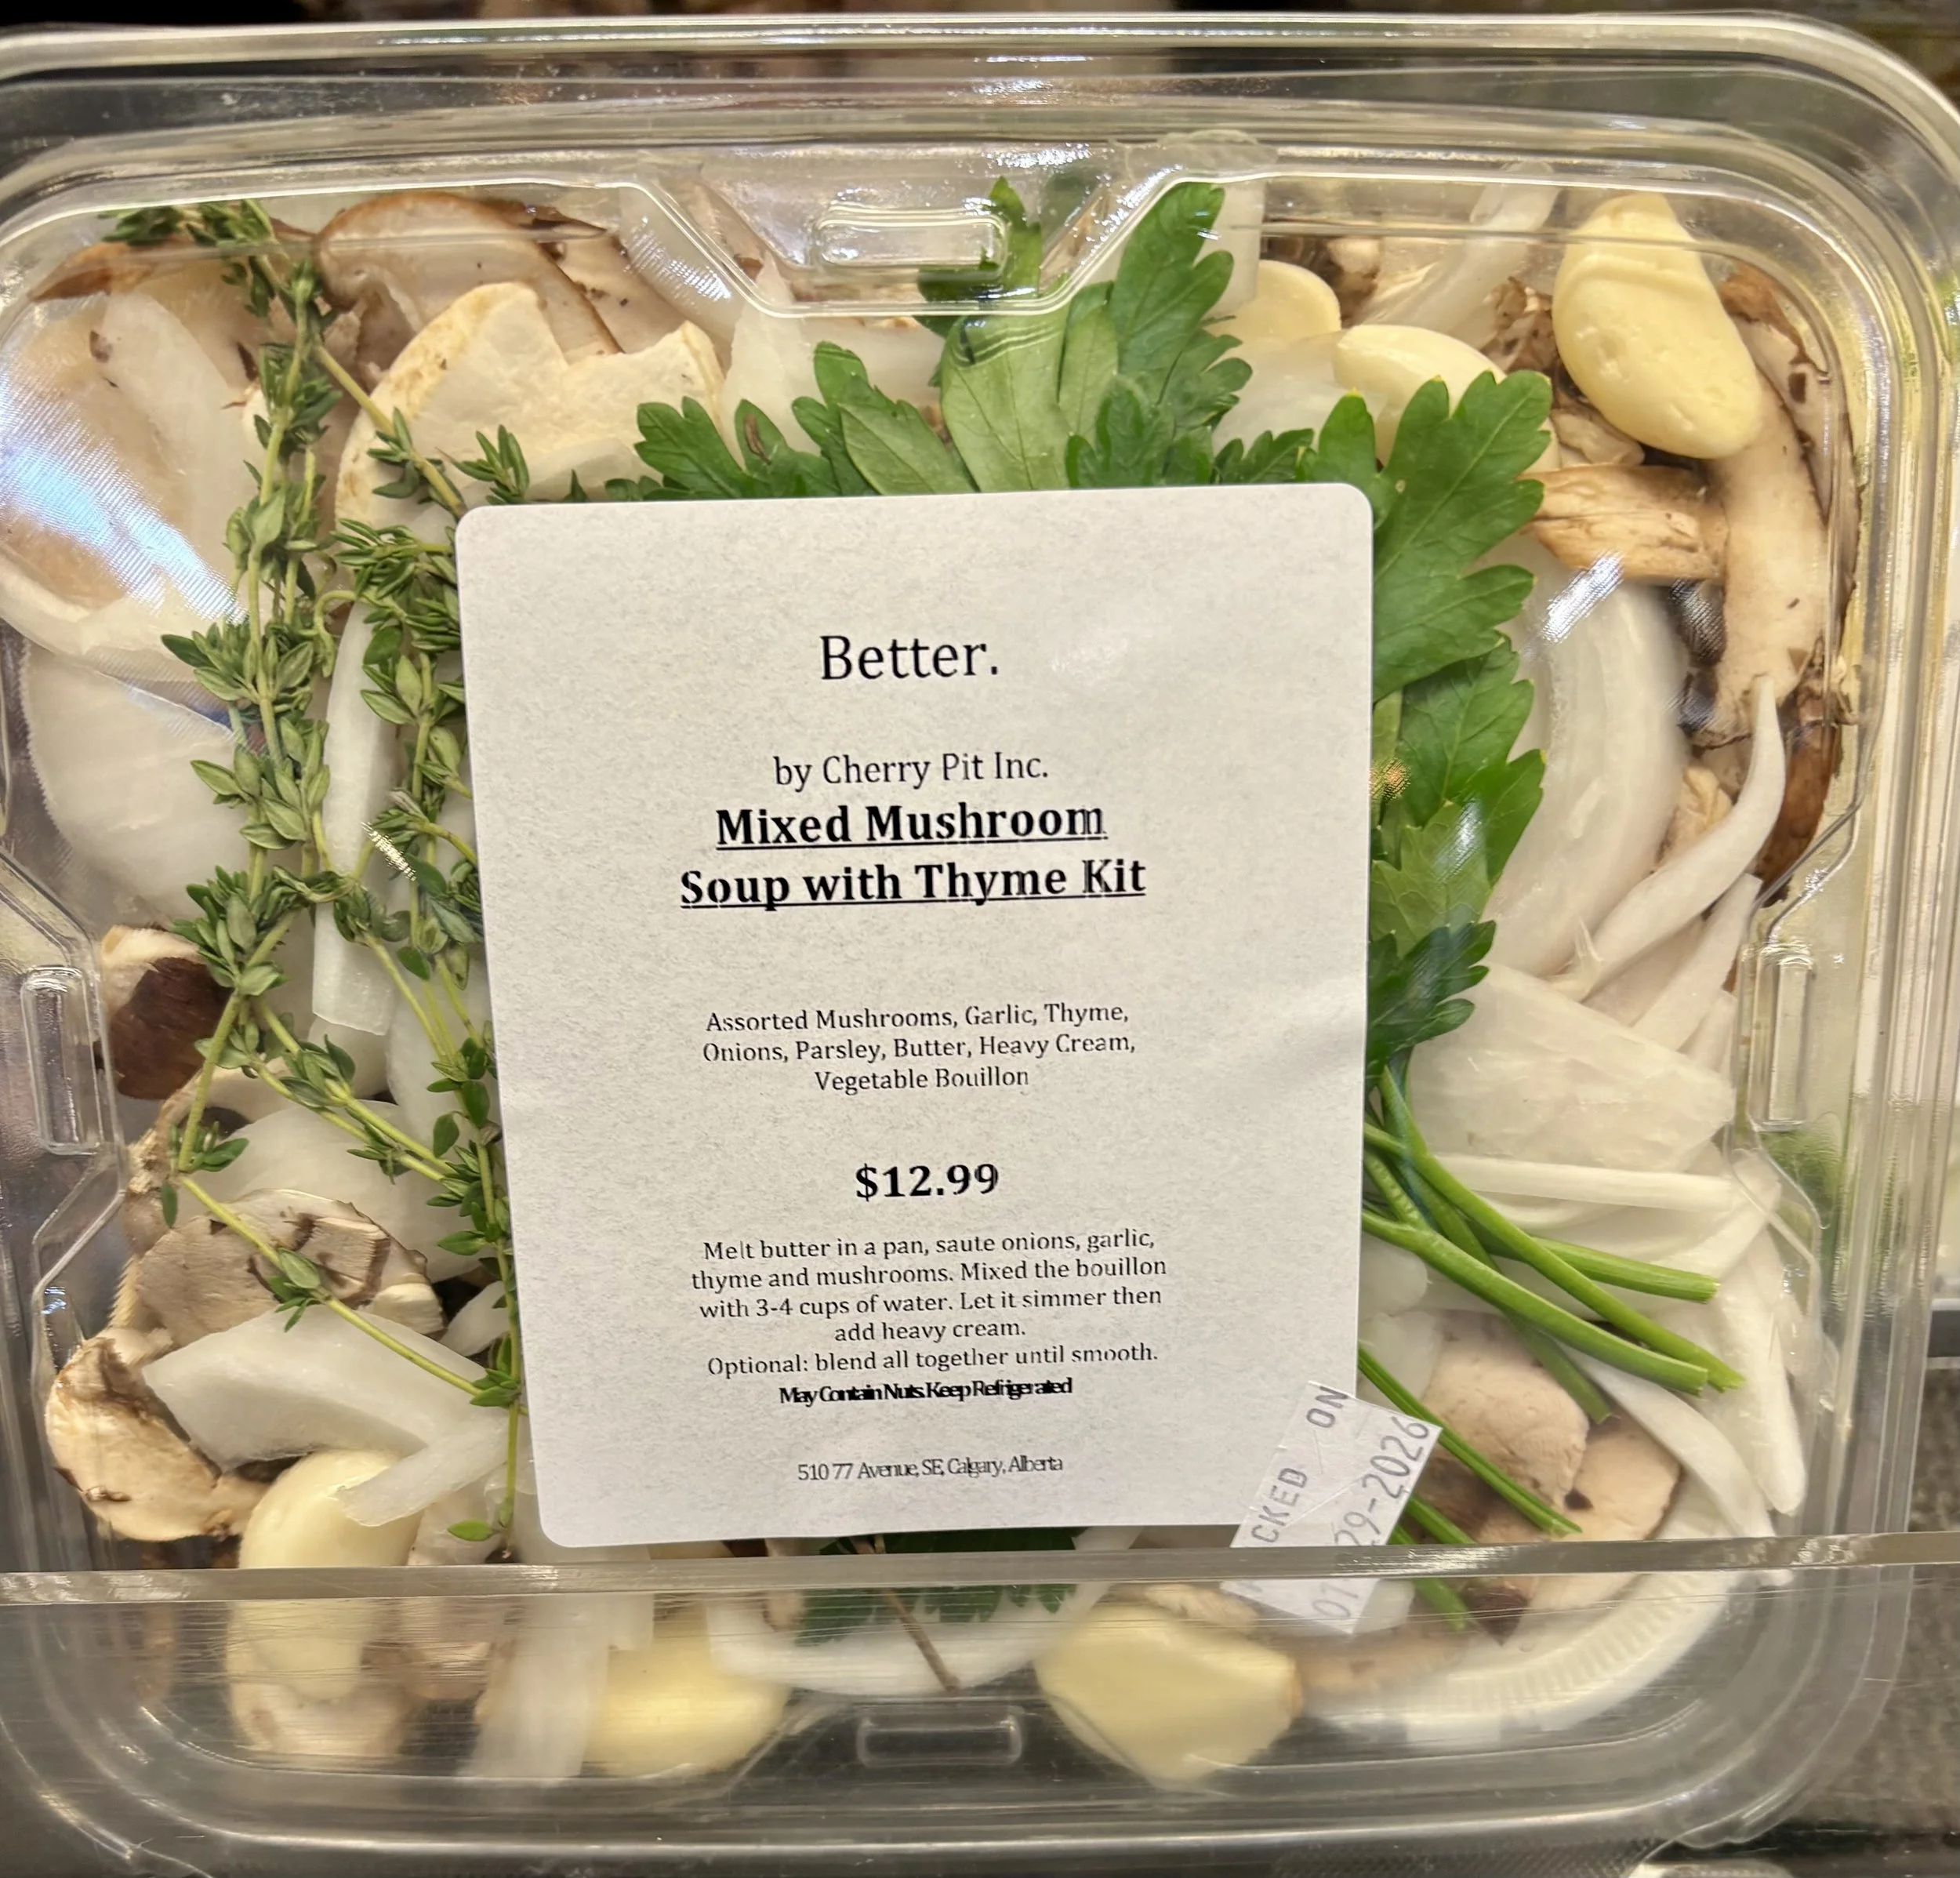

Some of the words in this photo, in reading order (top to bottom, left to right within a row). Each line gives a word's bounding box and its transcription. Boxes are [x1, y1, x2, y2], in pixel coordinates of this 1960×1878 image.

[819, 634, 999, 681] Better.
[772, 755, 813, 794] by
[822, 754, 932, 790] Cherry
[942, 752, 985, 781] Pit
[994, 750, 1049, 779] Inc.
[716, 806, 851, 851] Mixed
[866, 802, 1109, 846] Mushroom
[680, 870, 792, 912] Soup
[801, 863, 905, 907] with
[913, 861, 1069, 907] Thyme
[1080, 858, 1147, 899] Kit
[705, 1008, 808, 1032] Assorted
[815, 1007, 958, 1030] Mushrooms,
[964, 1003, 1038, 1026] Garlic,
[1043, 1001, 1129, 1028] Thyme,
[702, 1042, 789, 1063] Onions,
[795, 1038, 887, 1064] Parsley,
[893, 1037, 972, 1059] Butter,
[978, 1035, 1050, 1059] Heavy
[1055, 1033, 1135, 1054] Cream,
[814, 1067, 929, 1096] Vegetable
[935, 1065, 1029, 1088] Bouillon
[855, 1162, 1000, 1203] $12.99
[702, 1240, 756, 1260] Melt
[759, 1239, 831, 1259] butter
[837, 1237, 858, 1256] in
[863, 1241, 877, 1255] a
[883, 1240, 930, 1260] pan,
[935, 1236, 996, 1254] saute
[1001, 1231, 1081, 1251] onions,
[1087, 1227, 1155, 1254] garlic,
[691, 1270, 763, 1295] thyme
[768, 1266, 810, 1288] and
[815, 1265, 954, 1286] mushrooms.
[960, 1259, 1028, 1281] Mixed
[1034, 1259, 1070, 1279] the
[1075, 1256, 1167, 1277] bouillon
[699, 1298, 750, 1318] with
[756, 1298, 793, 1317] 3-4
[799, 1300, 850, 1320] cups
[856, 1293, 880, 1313] of
[882, 1295, 953, 1313] water.
[960, 1291, 996, 1310] Let
[1000, 1290, 1017, 1309] it
[1022, 1289, 1107, 1308] simmer
[1112, 1285, 1162, 1305] then
[834, 1322, 876, 1342] add
[880, 1321, 947, 1344] heavy
[953, 1323, 1026, 1338] cream.
[707, 1353, 808, 1380] Optional:
[814, 1350, 877, 1371] blend
[882, 1349, 909, 1369] all
[915, 1347, 1009, 1372] together
[1015, 1344, 1065, 1364] until
[1071, 1342, 1158, 1363] smooth.
[778, 1386, 821, 1408] May
[924, 1381, 972, 1403] Keep
[1306, 1386, 1348, 1429] ON
[797, 1463, 829, 1481] 510
[832, 1462, 854, 1480] 77
[1007, 1455, 1063, 1473] Alberta
